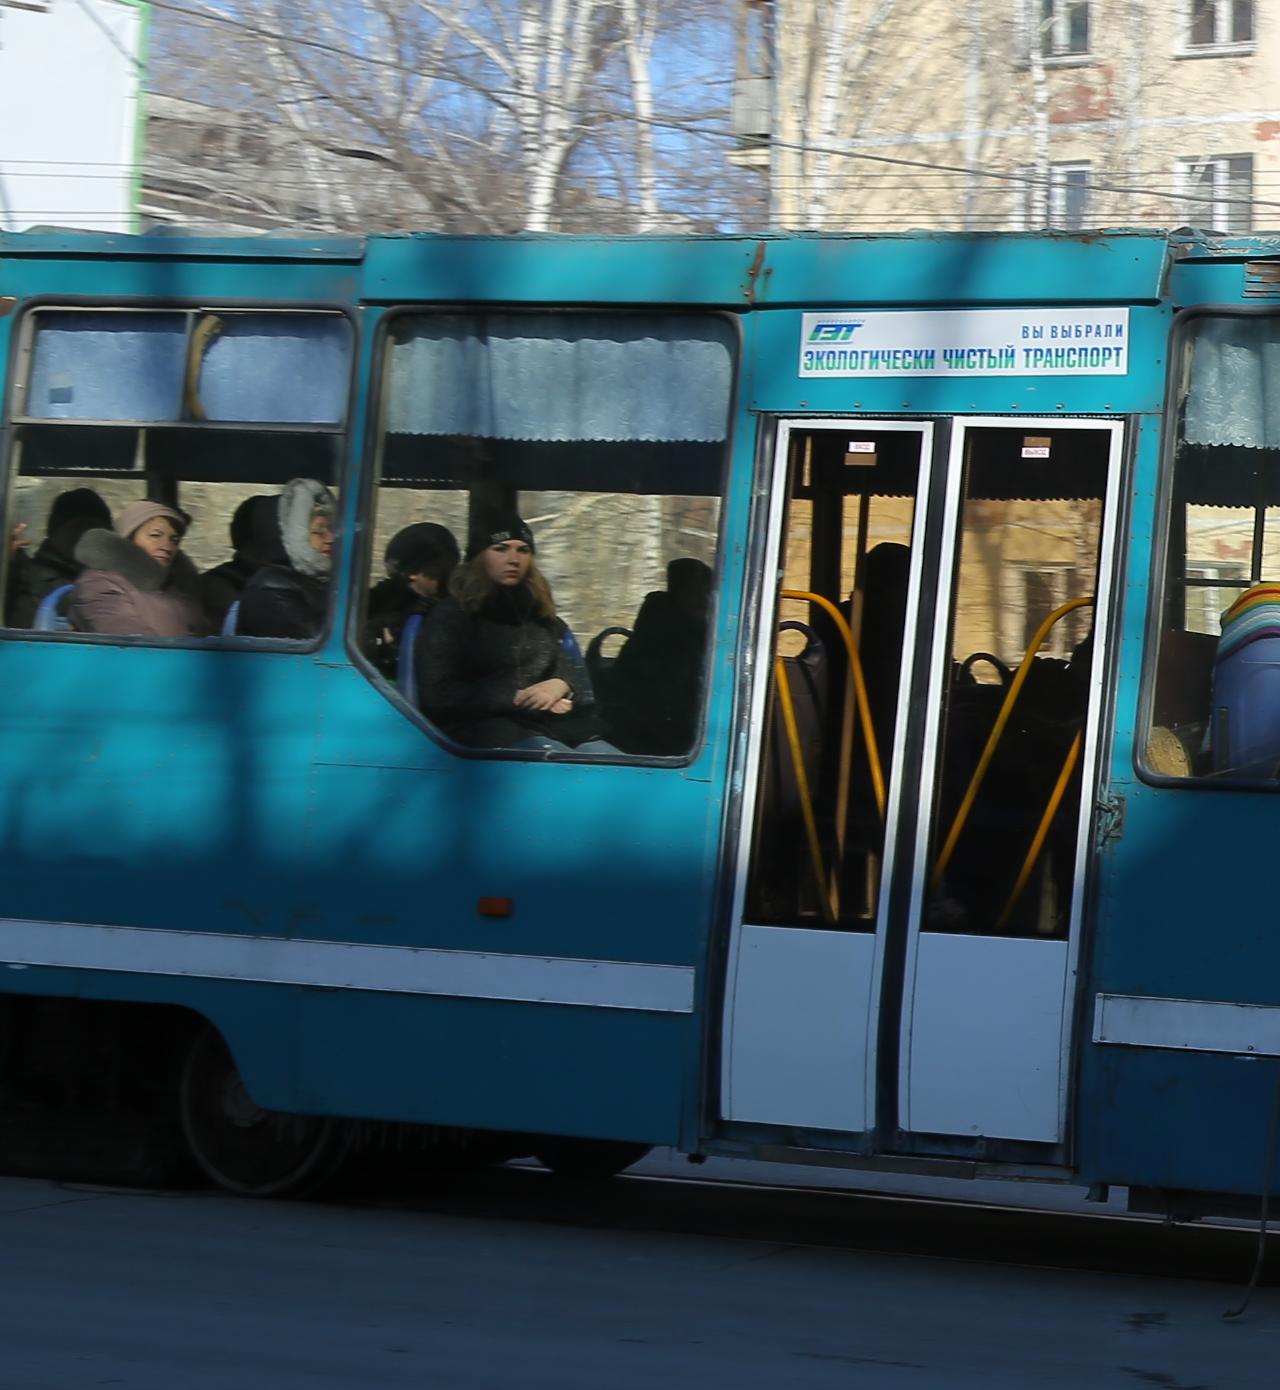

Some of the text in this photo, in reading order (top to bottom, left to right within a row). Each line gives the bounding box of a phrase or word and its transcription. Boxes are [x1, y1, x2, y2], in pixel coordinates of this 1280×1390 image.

[1021, 323, 1124, 339] ВЫ ВЫБРАЛИ
[803, 345, 1124, 371] ЭКОЛОГИЧЕСКИ ЧИСТЫЙ ТРАНСПОРТ
